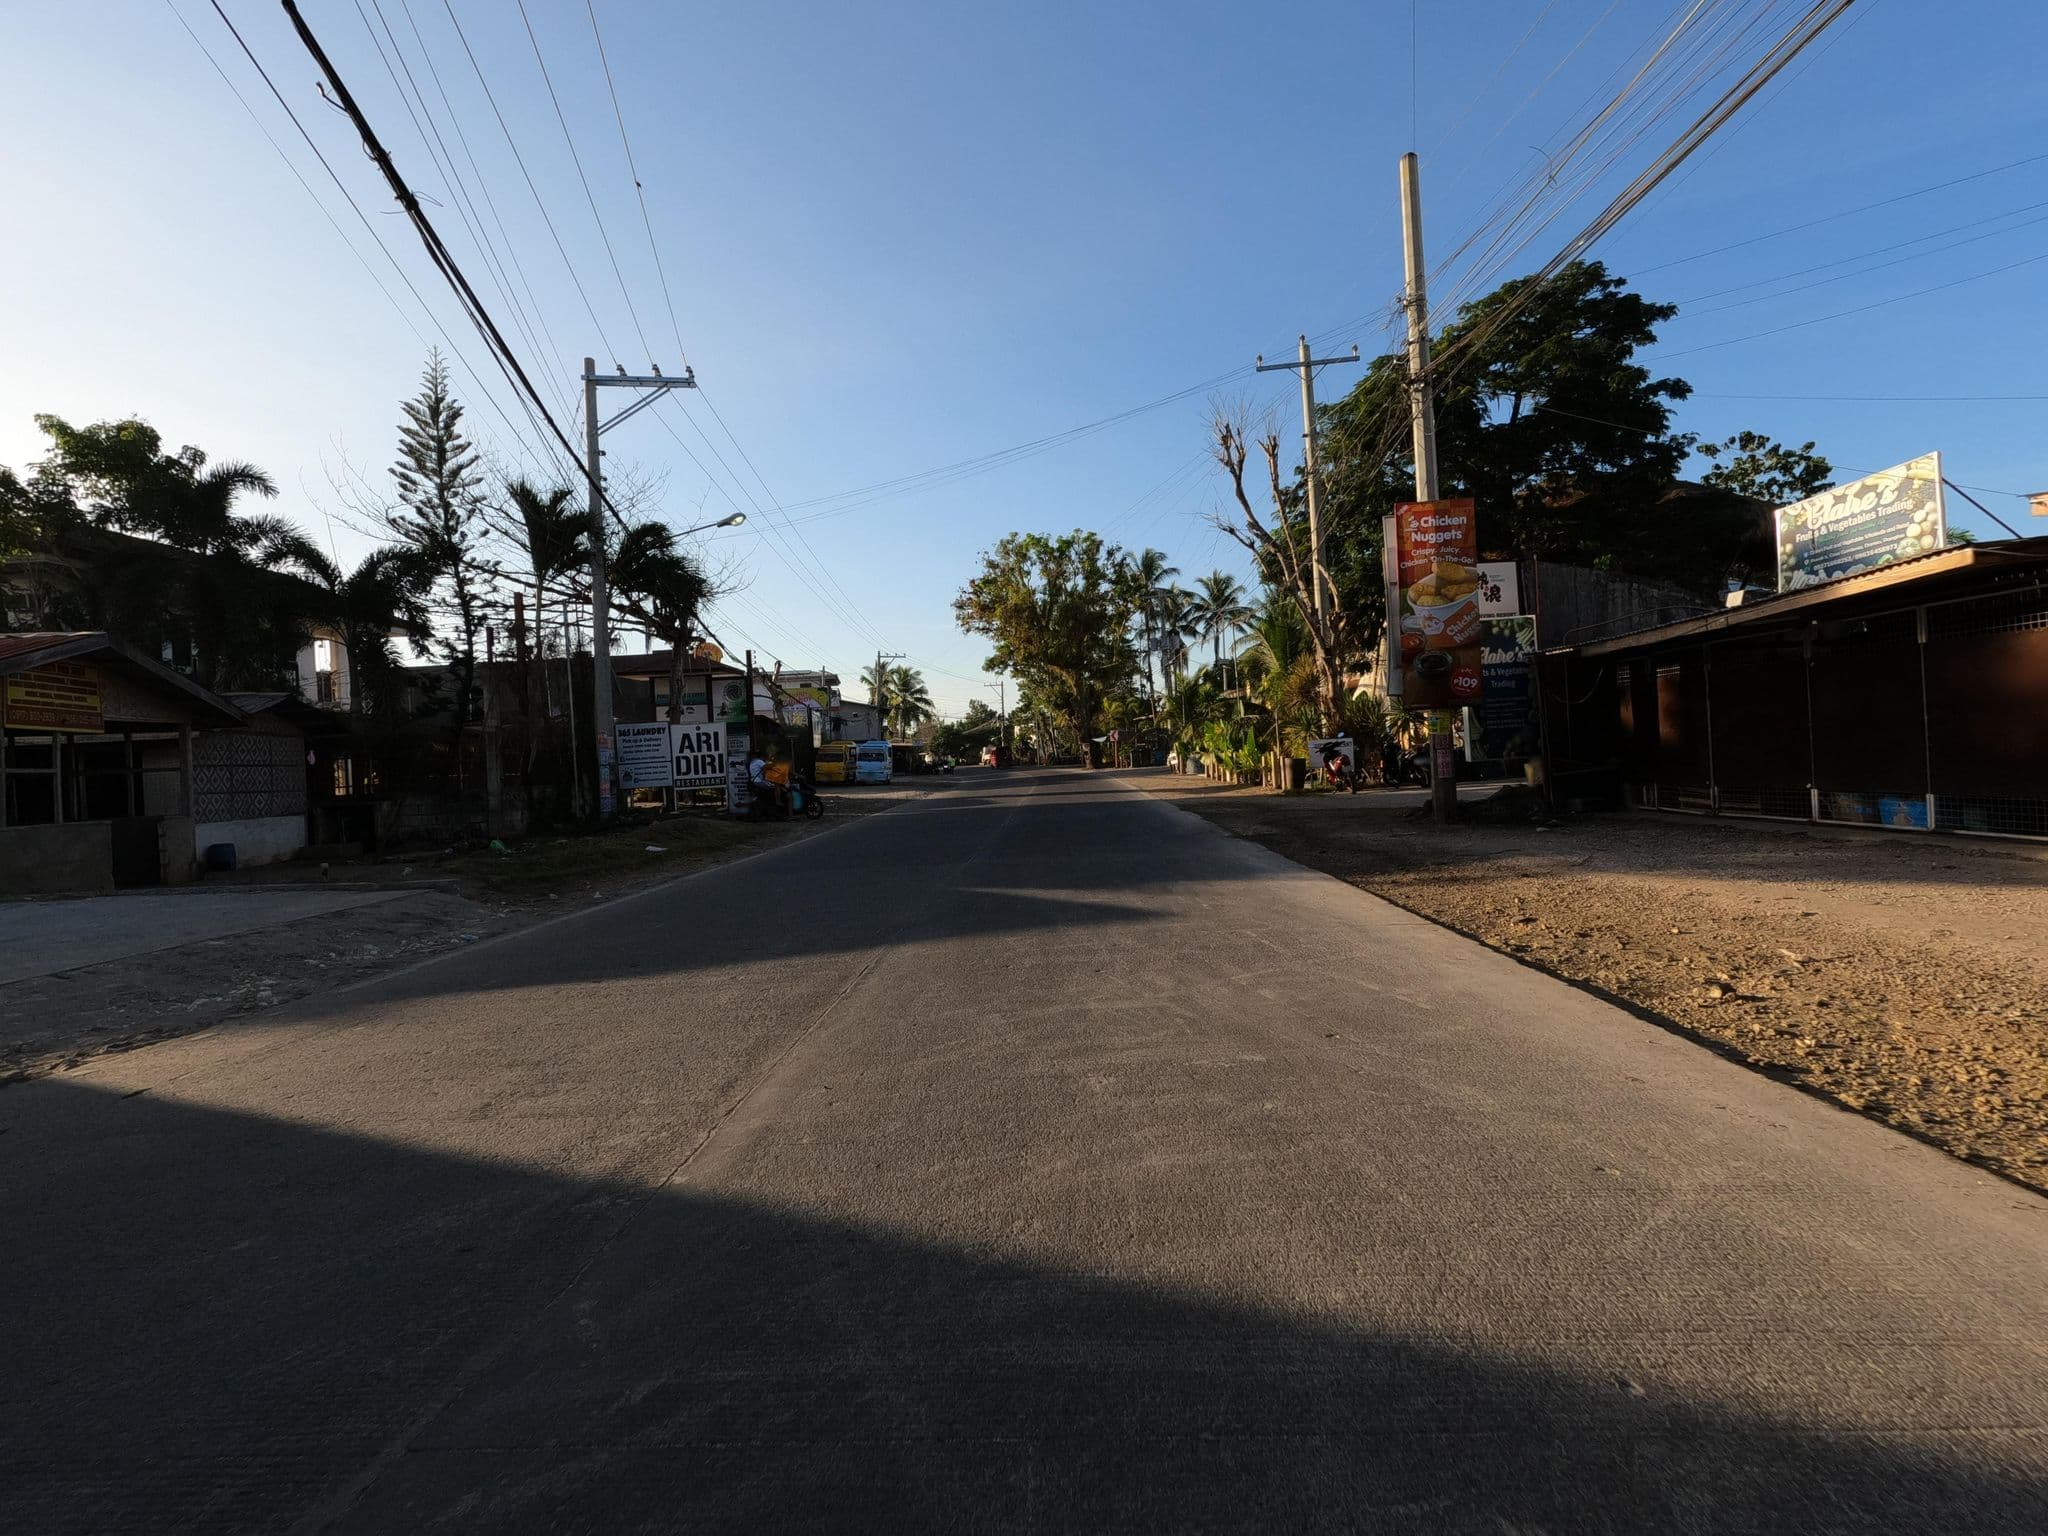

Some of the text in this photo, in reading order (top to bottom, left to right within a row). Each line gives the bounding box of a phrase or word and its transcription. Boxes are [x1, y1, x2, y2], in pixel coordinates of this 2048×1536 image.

[1804, 480, 1898, 530] Claire's
[1420, 515, 1467, 527] Chicken
[1828, 511, 1877, 532] Vegetables
[1877, 499, 1914, 517] Trading
[1411, 529, 1462, 543] Nuggets
[1400, 558, 1428, 569] Chicken
[632, 727, 666, 737] LAUNDRY
[679, 731, 720, 753] ARI
[675, 753, 725, 776] DIRI
[676, 777, 726, 787] RESTAURANT
